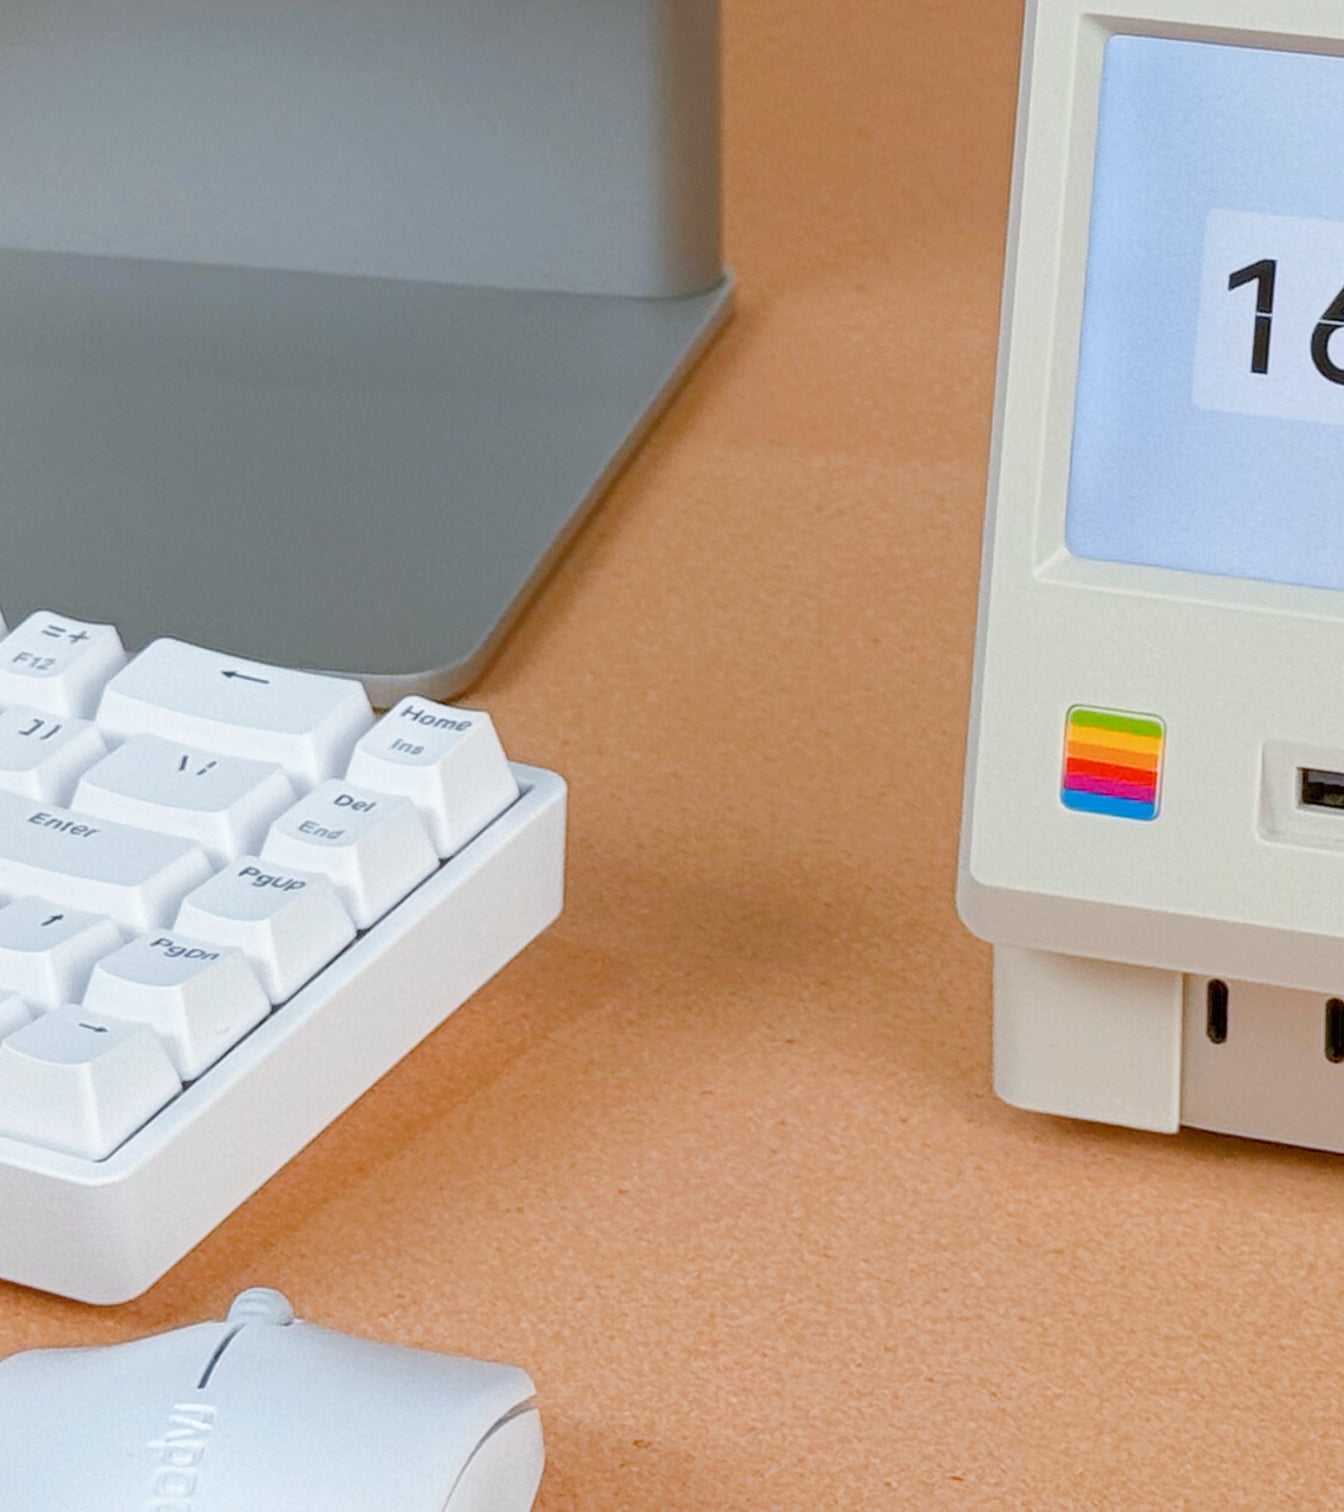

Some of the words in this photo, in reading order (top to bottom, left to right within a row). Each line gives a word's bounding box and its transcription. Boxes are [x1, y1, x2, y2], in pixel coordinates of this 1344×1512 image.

[12, 651, 57, 671] F12
[400, 705, 474, 733] Home
[390, 739, 425, 756] Ins
[334, 794, 377, 814] Del
[27, 812, 102, 839] Enter
[298, 820, 346, 841] End
[238, 866, 307, 892] PgUp
[150, 937, 221, 961] PgDn
